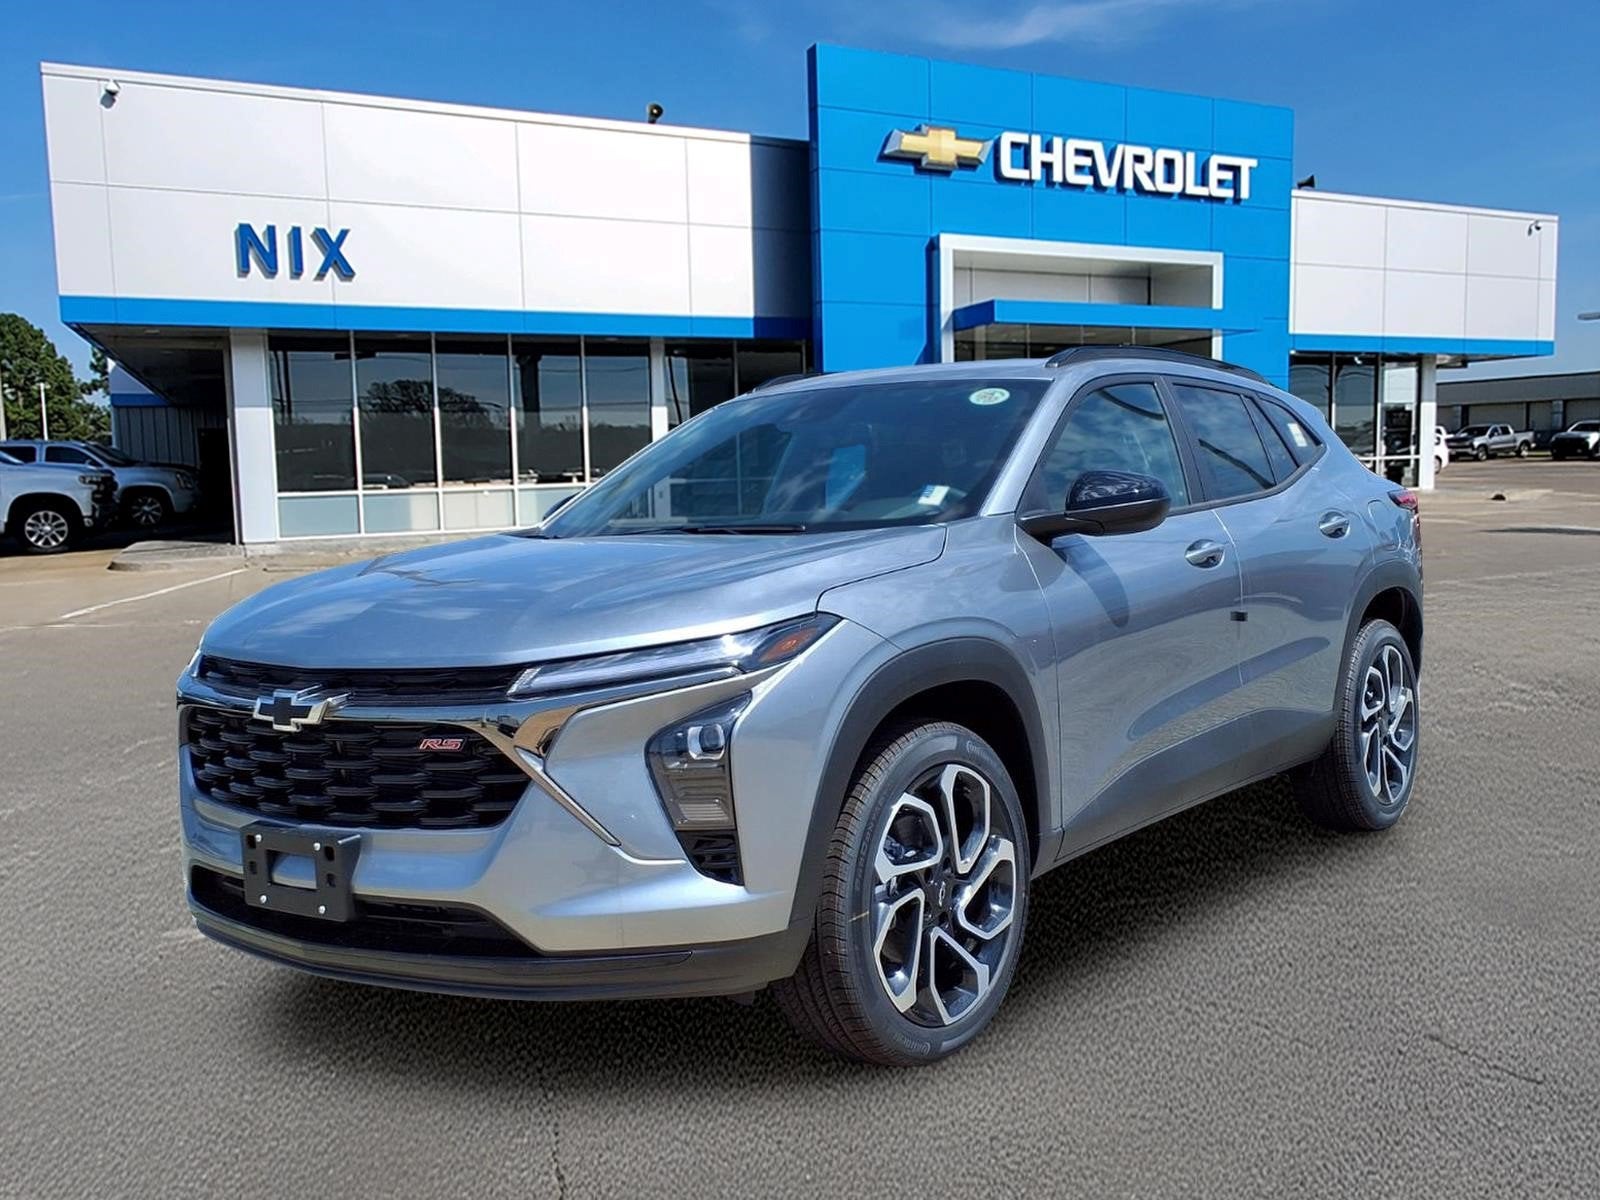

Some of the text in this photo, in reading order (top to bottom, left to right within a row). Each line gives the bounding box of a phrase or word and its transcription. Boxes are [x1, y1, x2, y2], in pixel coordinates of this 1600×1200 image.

[999, 131, 1258, 200] CHEVROLET
[234, 222, 356, 282] NIX
[419, 738, 464, 750] RS
